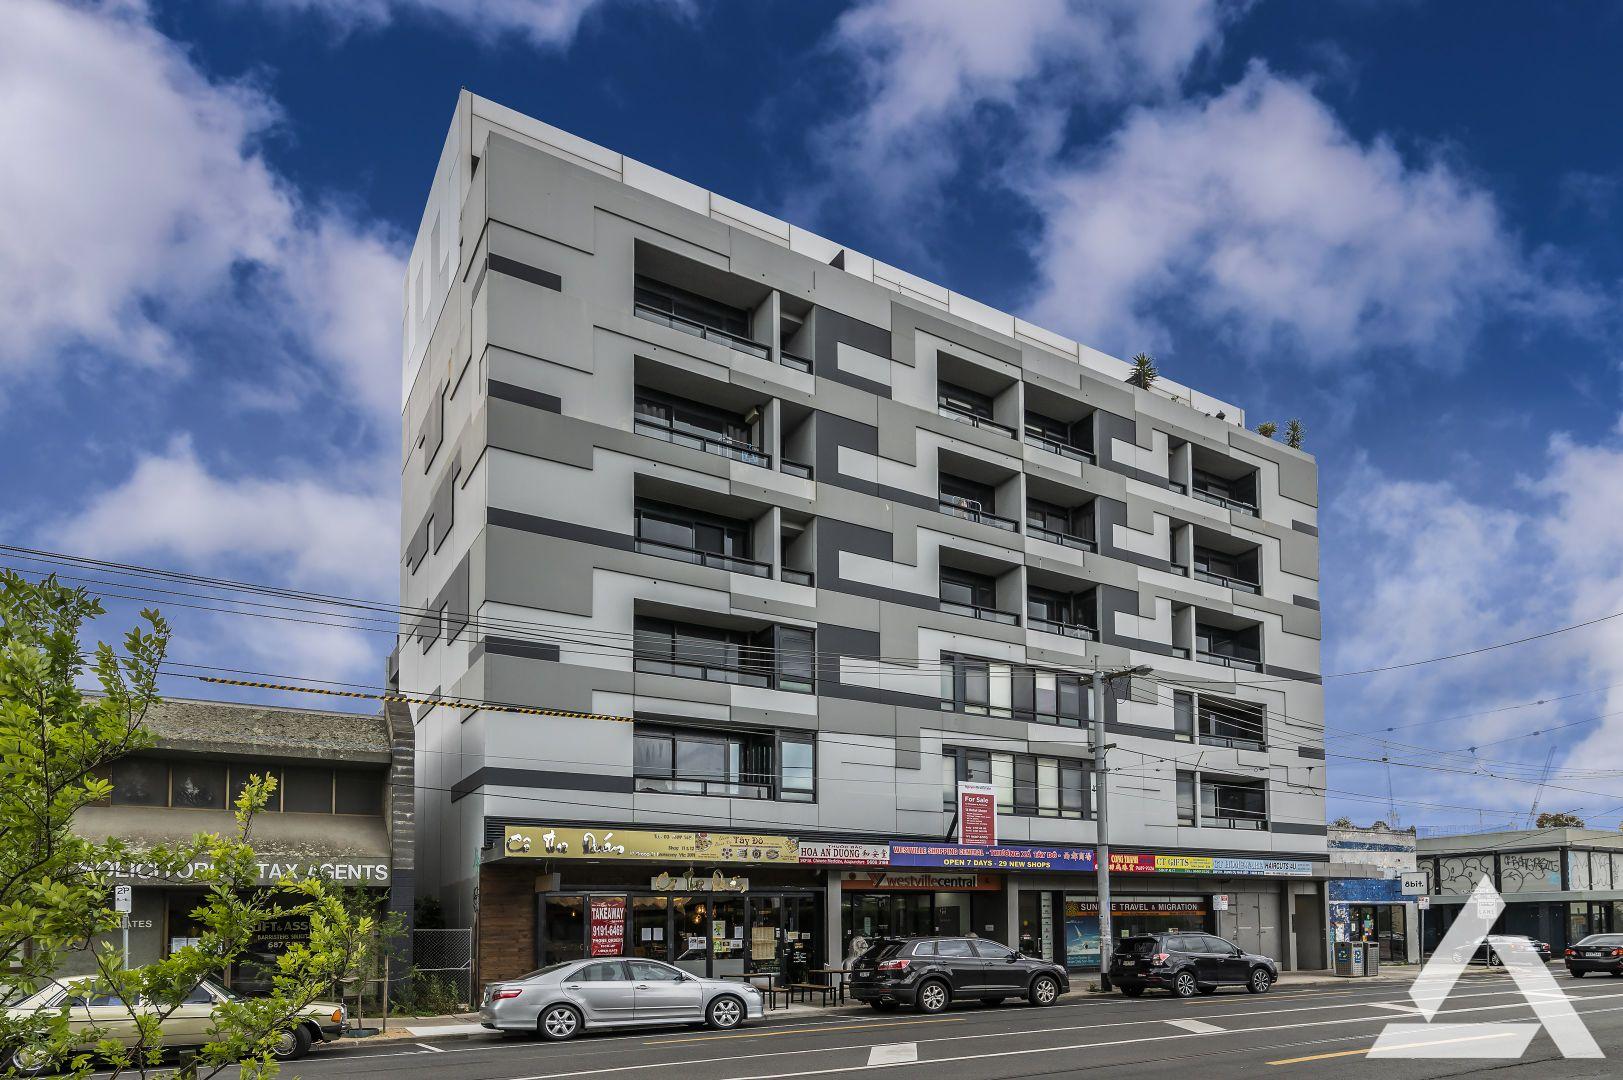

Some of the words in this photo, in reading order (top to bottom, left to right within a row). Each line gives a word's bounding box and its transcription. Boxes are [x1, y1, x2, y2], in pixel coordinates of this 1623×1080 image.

[801, 847, 818, 856] HOA
[820, 848, 831, 857] AN
[1167, 858, 1189, 867] GIFTS
[77, 860, 216, 879] OLICITOR
[256, 863, 299, 879] TAX
[886, 874, 976, 888] westvillecentral
[1404, 880, 1424, 888] 8bit.
[117, 887, 130, 895] 2P
[1081, 903, 1116, 911] SUNE
[1119, 903, 1149, 911] TRAVEL
[1158, 903, 1198, 911] MIGRATION
[591, 907, 624, 920] TAKEAWAY
[283, 921, 310, 932] ASS
